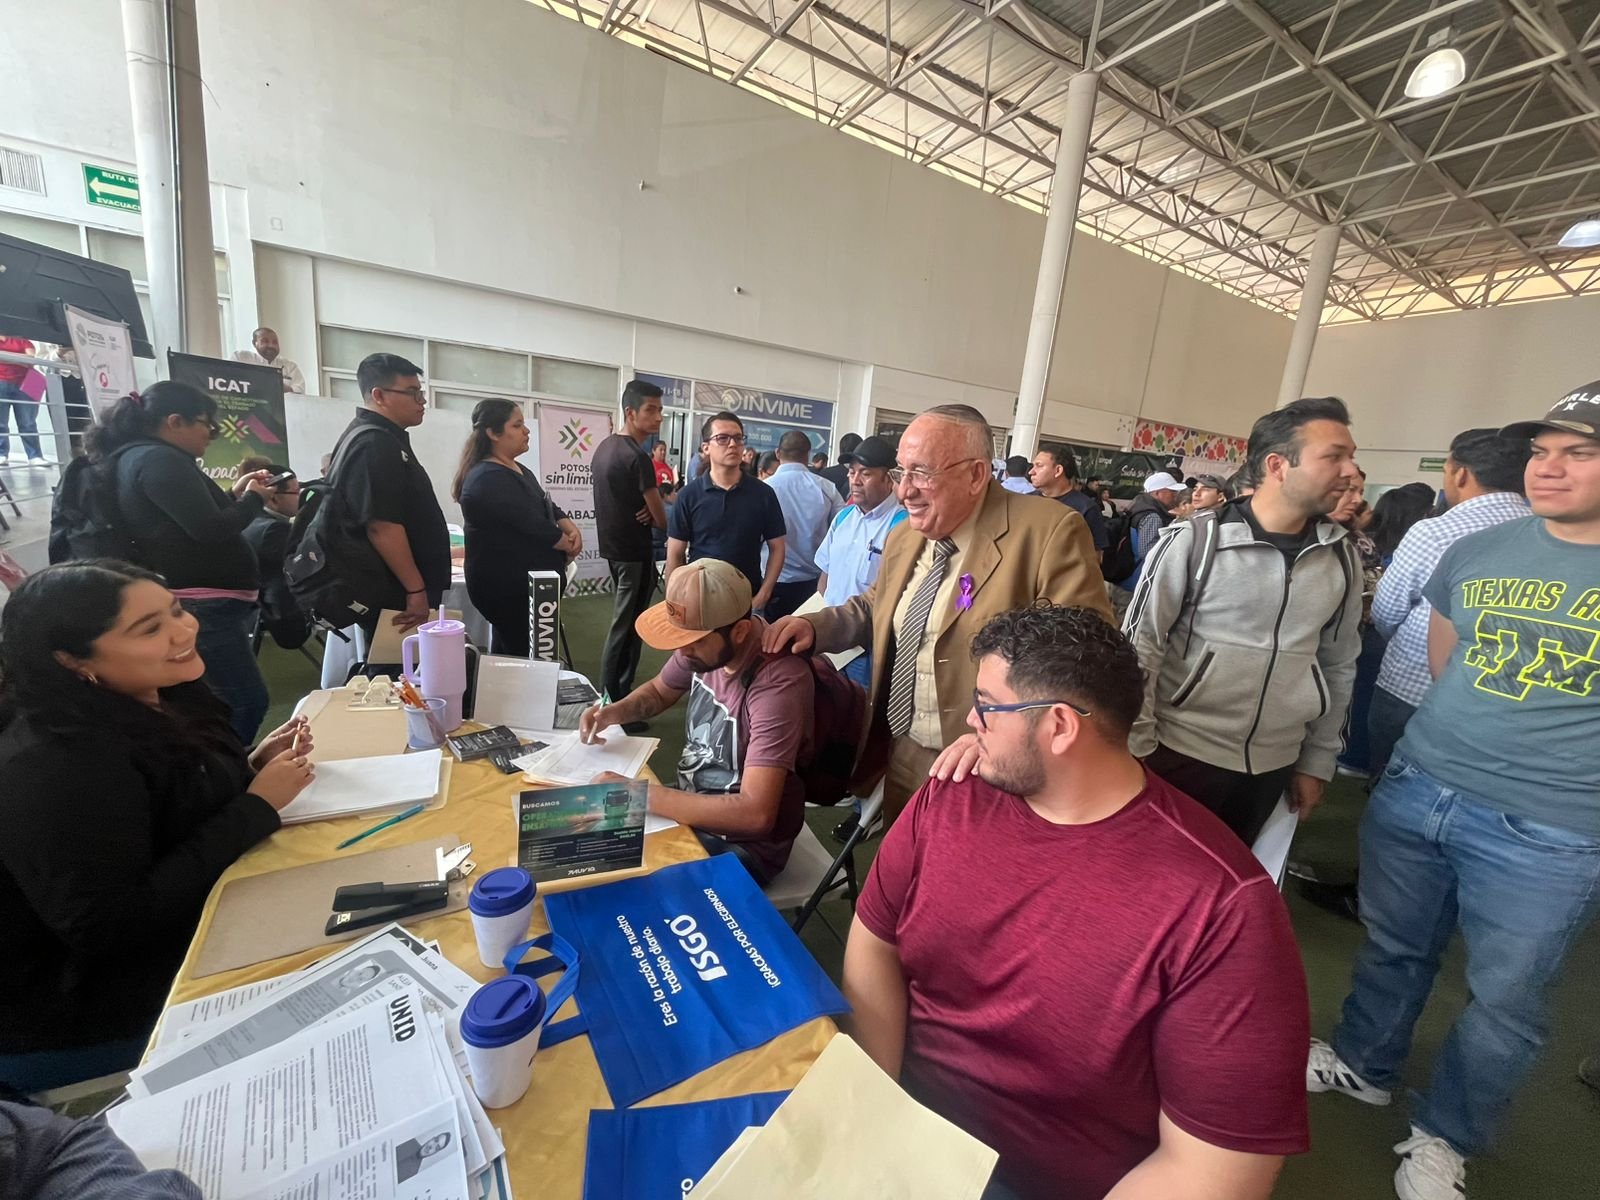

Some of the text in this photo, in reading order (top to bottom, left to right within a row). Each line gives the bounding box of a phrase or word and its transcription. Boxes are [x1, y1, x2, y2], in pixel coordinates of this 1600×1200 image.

[102, 171, 126, 181] RUTA
[208, 376, 251, 394] ICAT
[743, 395, 813, 420] INVIME
[545, 471, 565, 484] sin
[1462, 578, 1600, 622] TEXAS A
[522, 801, 560, 809] BUSCAMOS
[732, 928, 752, 948] POR
[616, 915, 678, 1026] Eres la razón de nuestro
[642, 926, 682, 994] trabajo diario.
[390, 994, 416, 1042] UNID
